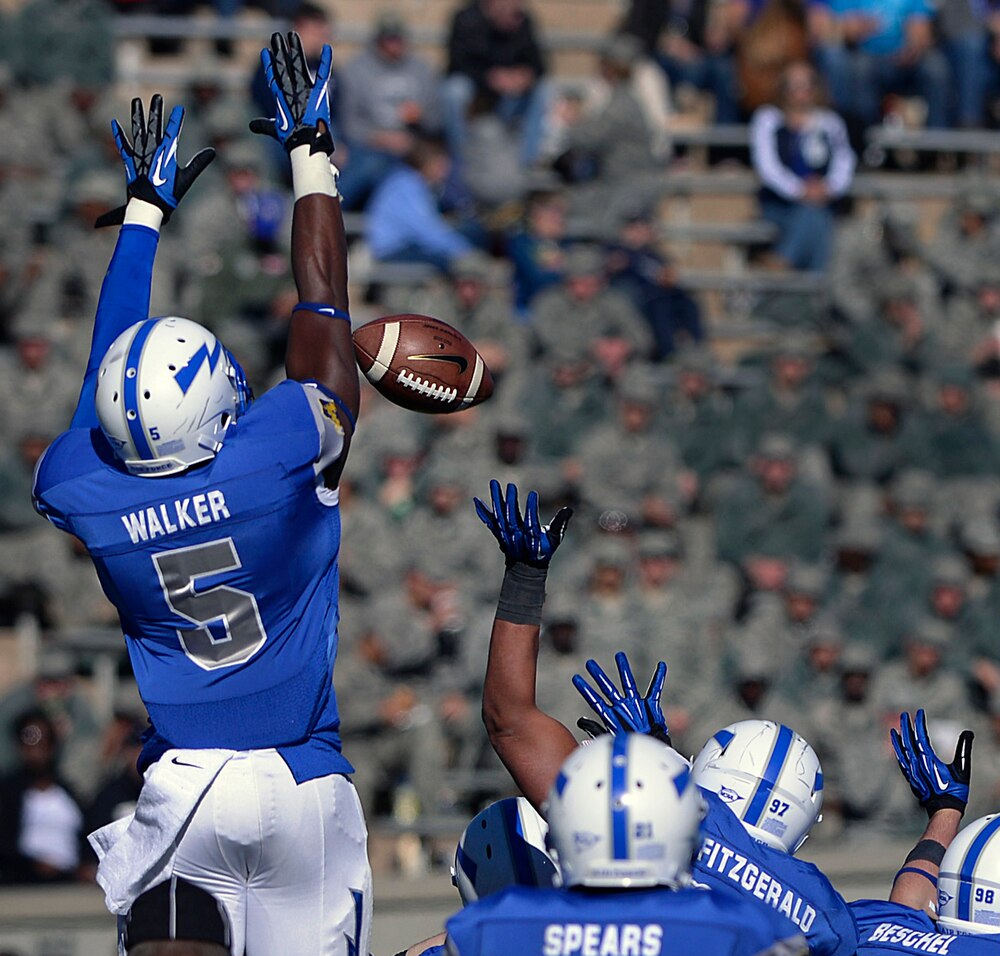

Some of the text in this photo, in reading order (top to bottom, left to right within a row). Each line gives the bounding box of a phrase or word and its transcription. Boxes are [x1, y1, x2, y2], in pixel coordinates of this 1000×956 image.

[148, 427, 160, 441] 5
[121, 490, 231, 544] WALKER
[151, 537, 267, 671] 5
[769, 798, 790, 817] 97
[697, 838, 816, 933] FITZGERALD
[975, 888, 995, 904] 98
[868, 923, 957, 955] BESCHEL
